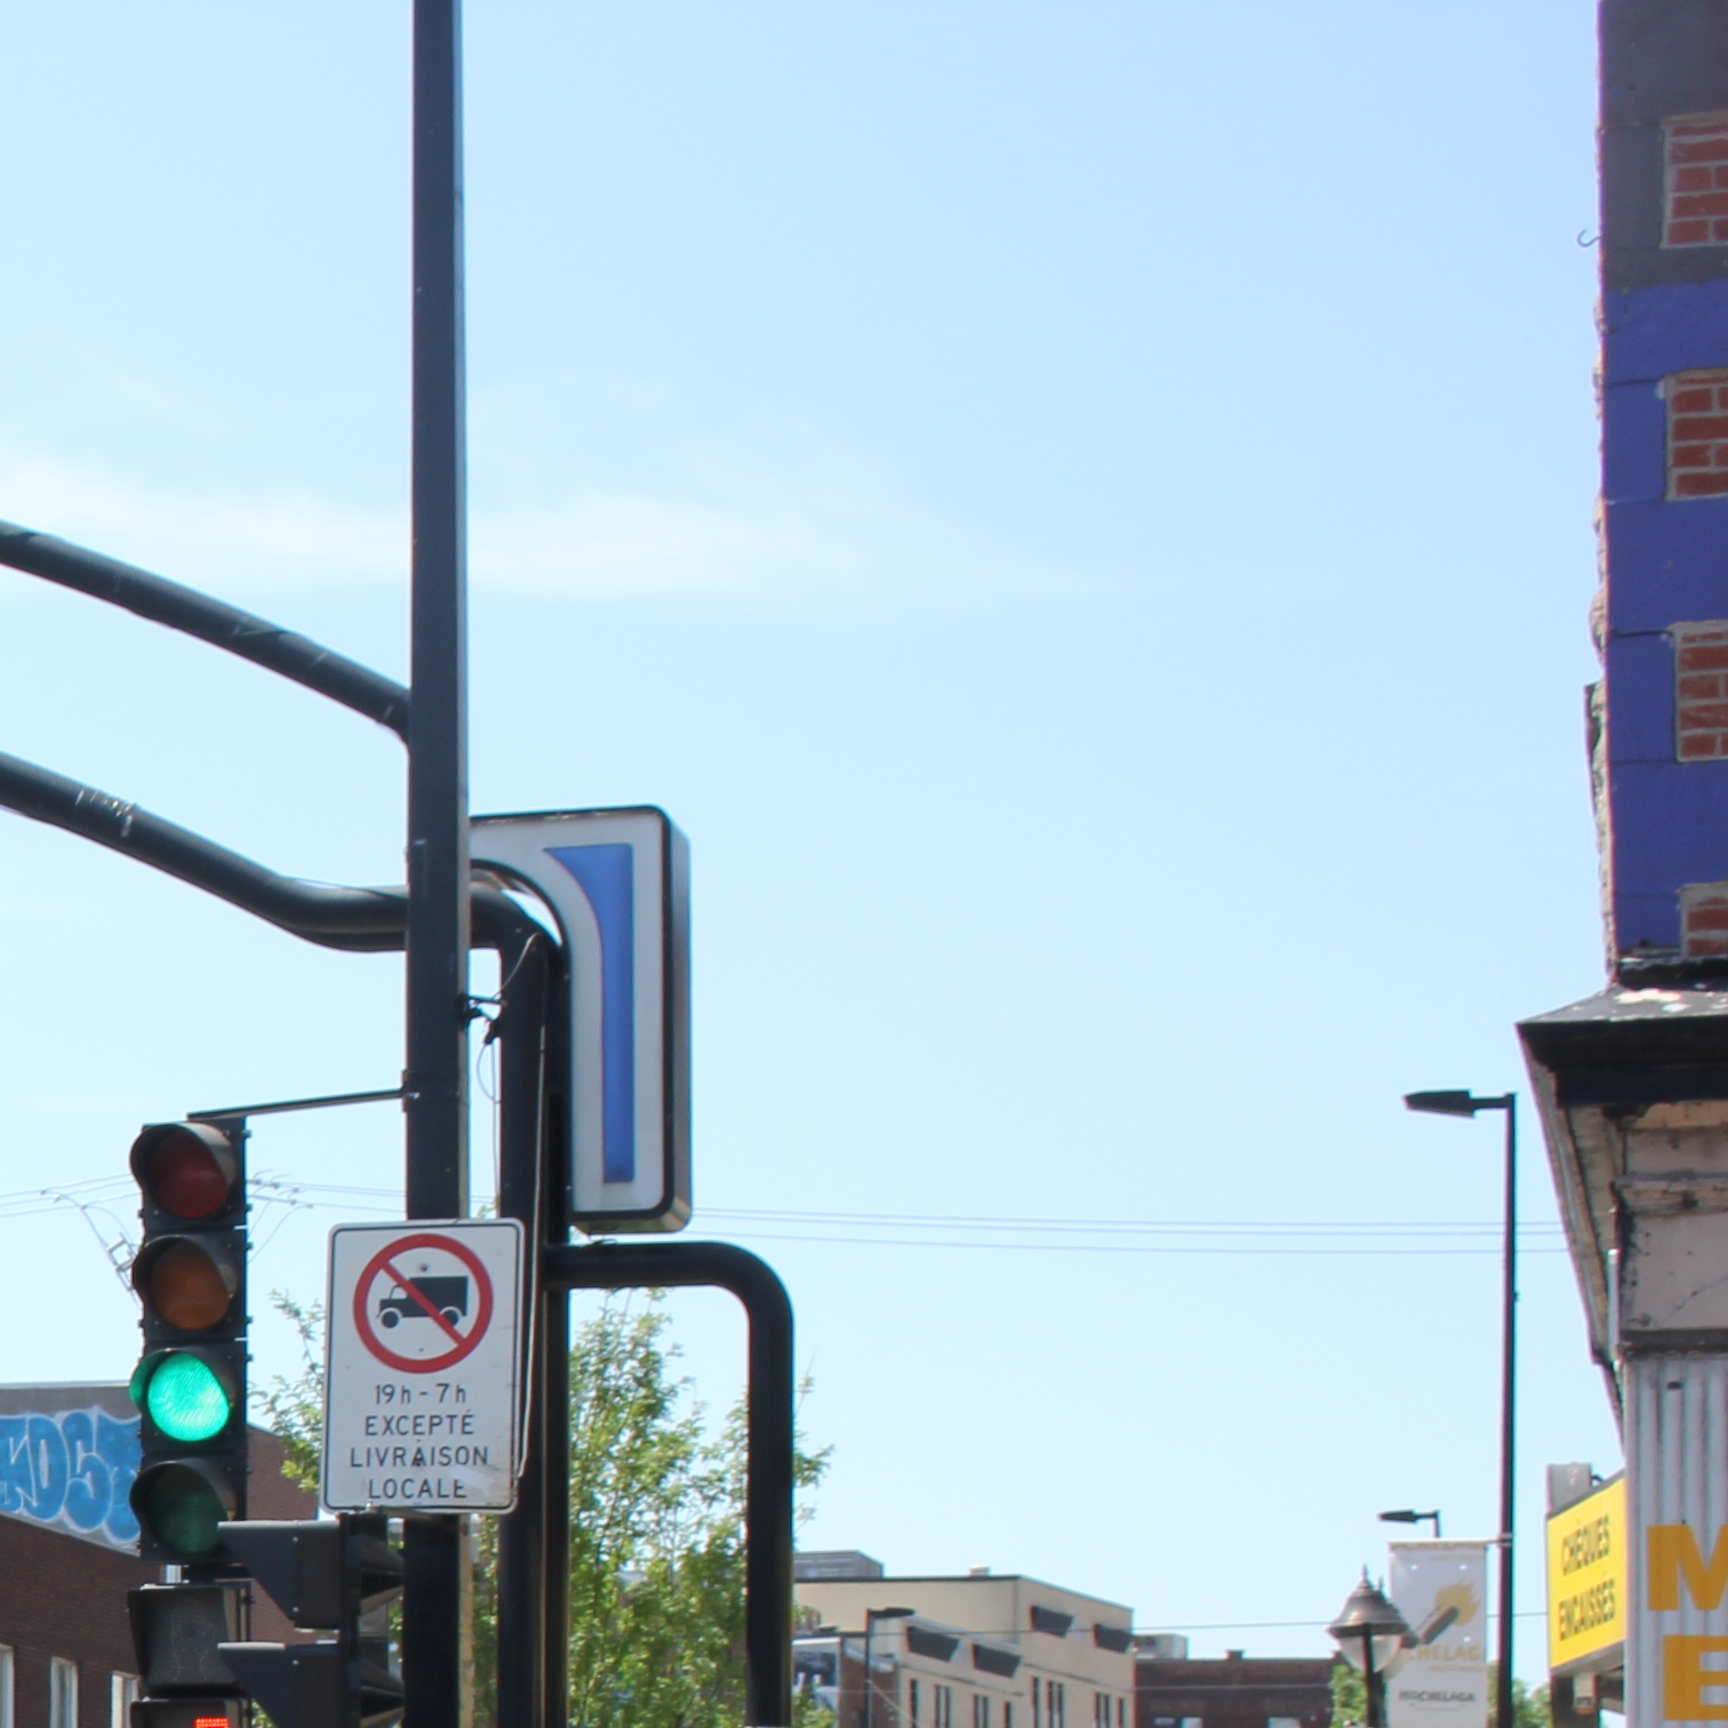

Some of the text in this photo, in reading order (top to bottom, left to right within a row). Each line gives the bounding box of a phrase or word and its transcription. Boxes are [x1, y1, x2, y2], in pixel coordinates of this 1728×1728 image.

[364, 1408, 475, 1437] EXCEPTÉ
[350, 1445, 489, 1468] LIVRAISON
[368, 1477, 468, 1500] LOCALE
